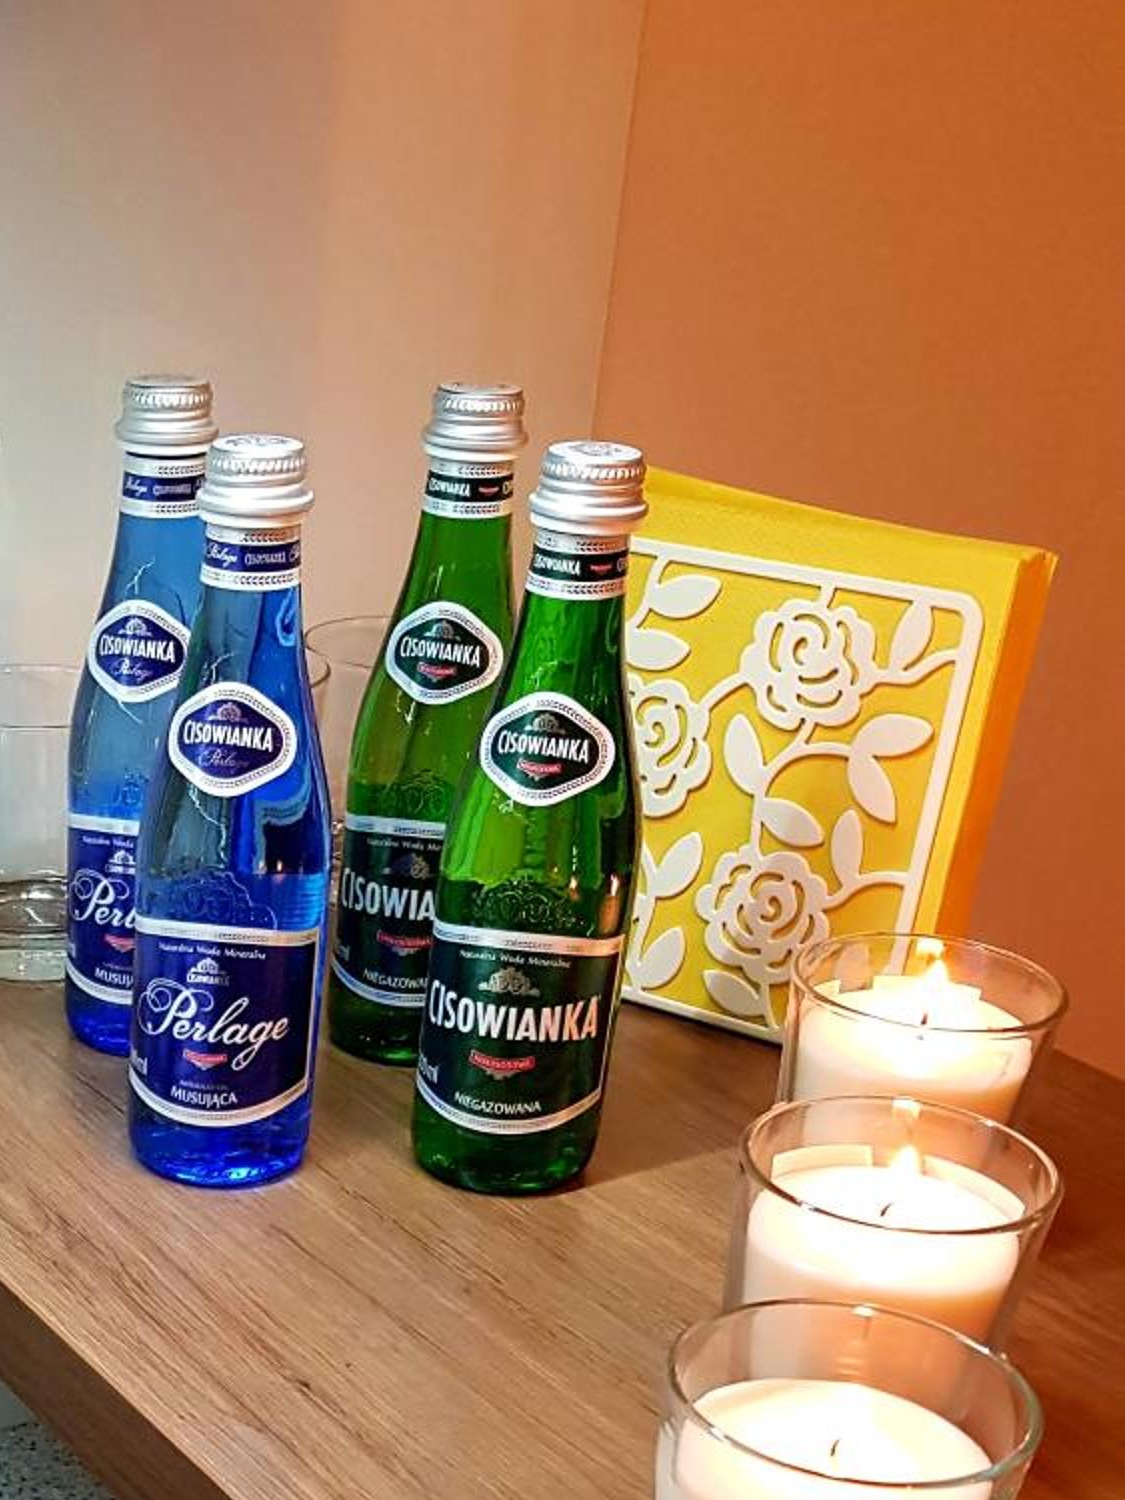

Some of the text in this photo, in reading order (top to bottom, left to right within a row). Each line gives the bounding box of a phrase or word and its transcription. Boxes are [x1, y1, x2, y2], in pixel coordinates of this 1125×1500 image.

[99, 634, 175, 663] CISOWIANKA
[400, 635, 481, 668] CISOWIANKA
[183, 719, 274, 752] CISOWIANKA
[497, 729, 589, 764] CISOWIANKA
[342, 867, 437, 922] CISOWIA
[138, 977, 289, 1071] Perlage
[428, 978, 600, 1042] CISOWIANKA
[454, 1090, 542, 1115] NIEGAZOWANA
